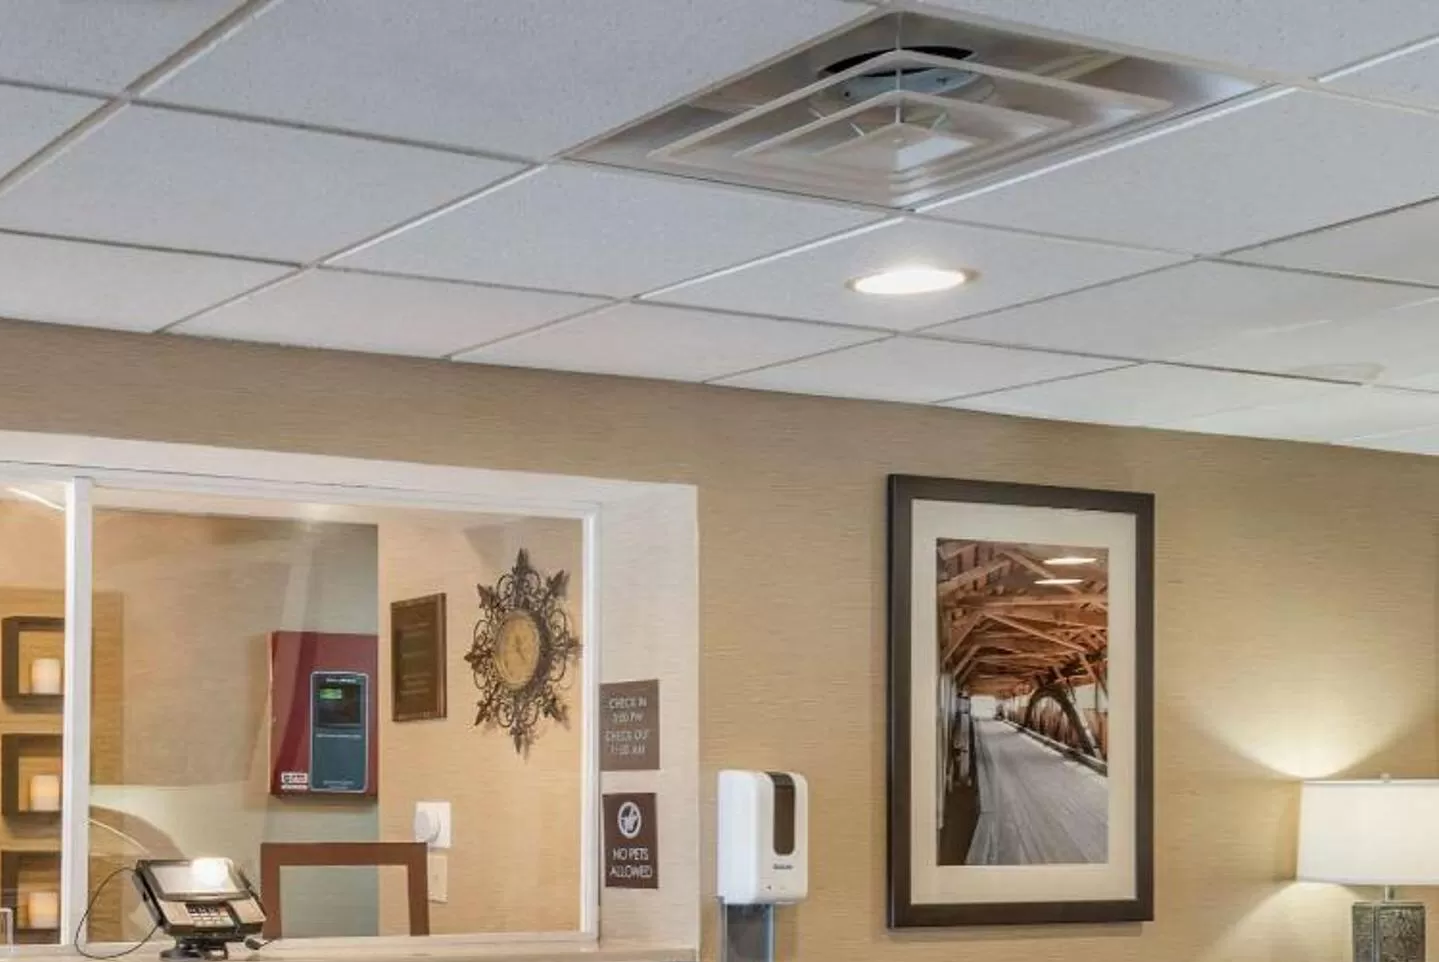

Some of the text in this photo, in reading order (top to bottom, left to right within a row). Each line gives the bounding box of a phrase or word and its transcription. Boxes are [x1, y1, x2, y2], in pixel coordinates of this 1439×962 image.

[612, 848, 649, 860] NO PETS
[610, 864, 653, 879] ALLOWED
